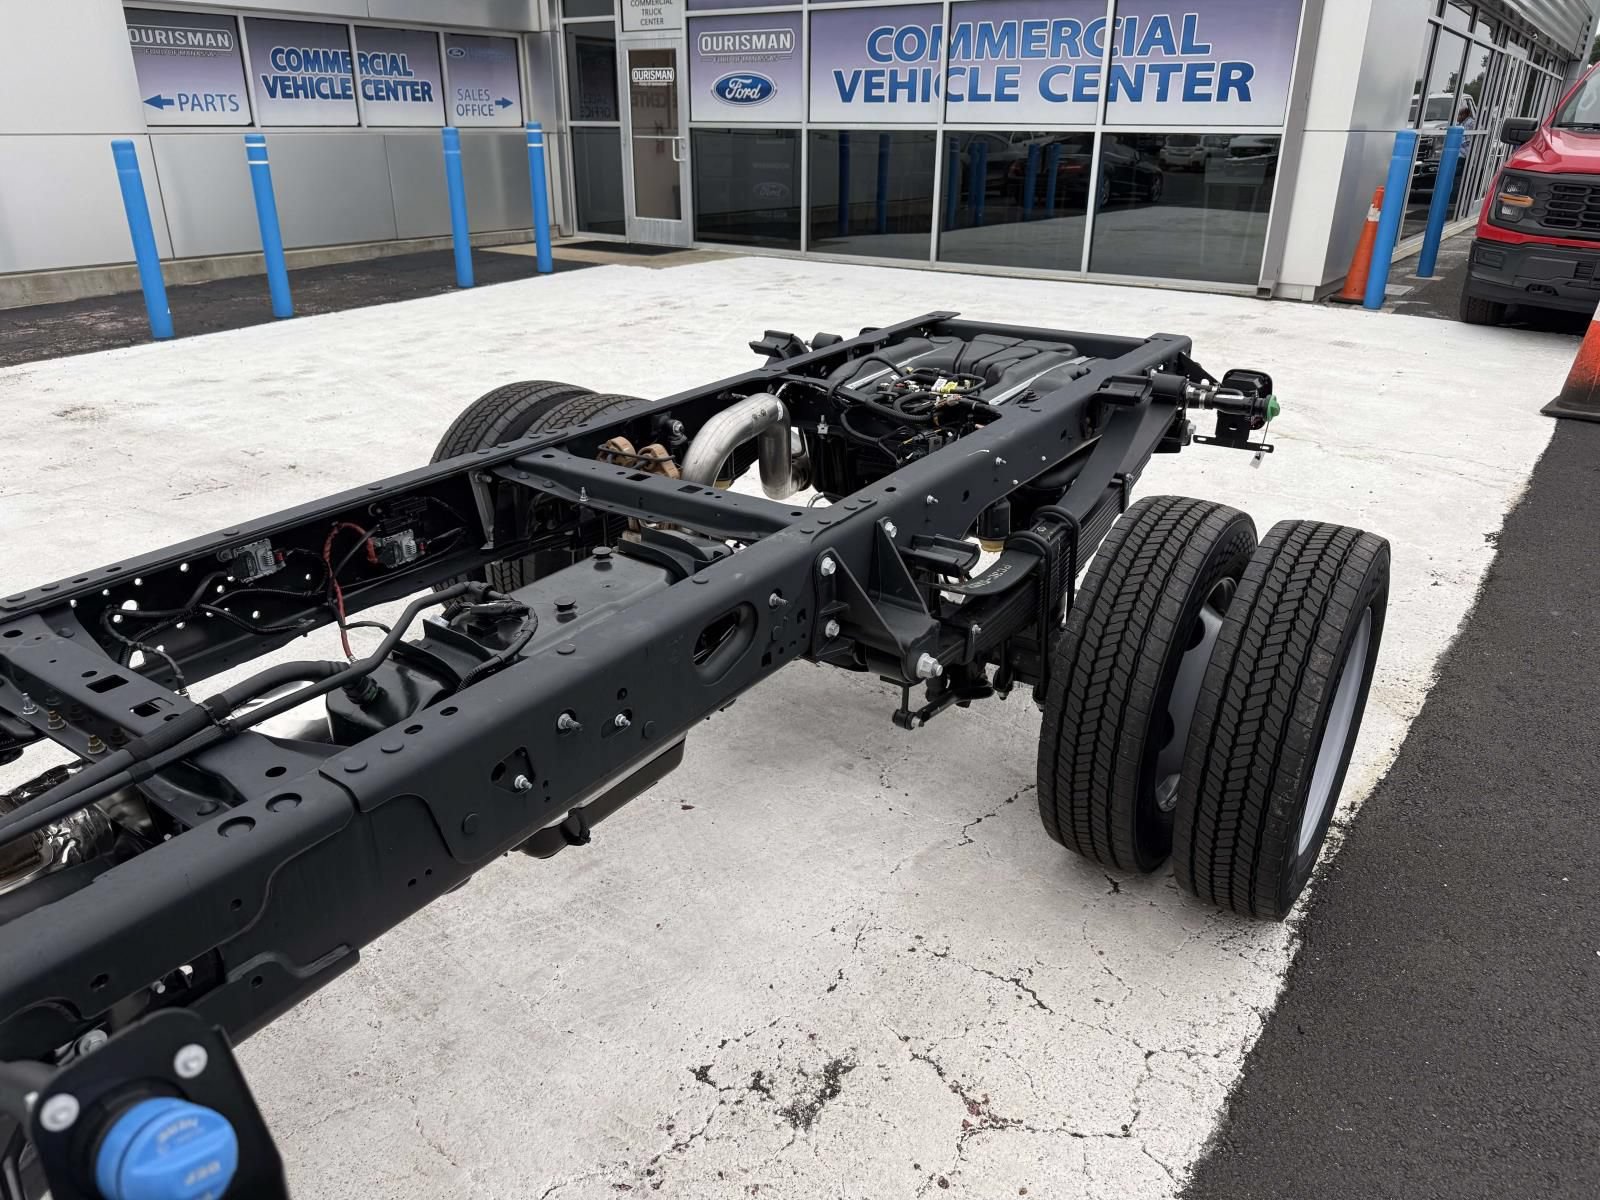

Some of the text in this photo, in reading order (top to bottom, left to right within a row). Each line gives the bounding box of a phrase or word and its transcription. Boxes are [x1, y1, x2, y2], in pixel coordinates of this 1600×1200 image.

[640, 17, 664, 26] CENTER
[641, 8, 662, 16] TRUCK
[128, 28, 230, 47] OURISMAN
[701, 33, 791, 51] OURISMAN
[865, 13, 1212, 64] COMMERCIAL
[270, 46, 414, 77] COMMERCIAL
[633, 70, 673, 80] OURISMAN
[832, 60, 1256, 104] VEHICLE CENTER
[260, 74, 434, 103] VEHICLE CENTER
[456, 87, 491, 102] SALES
[725, 78, 761, 99] Ford
[177, 92, 240, 113] PARTS
[456, 102, 495, 117] OFFICE
